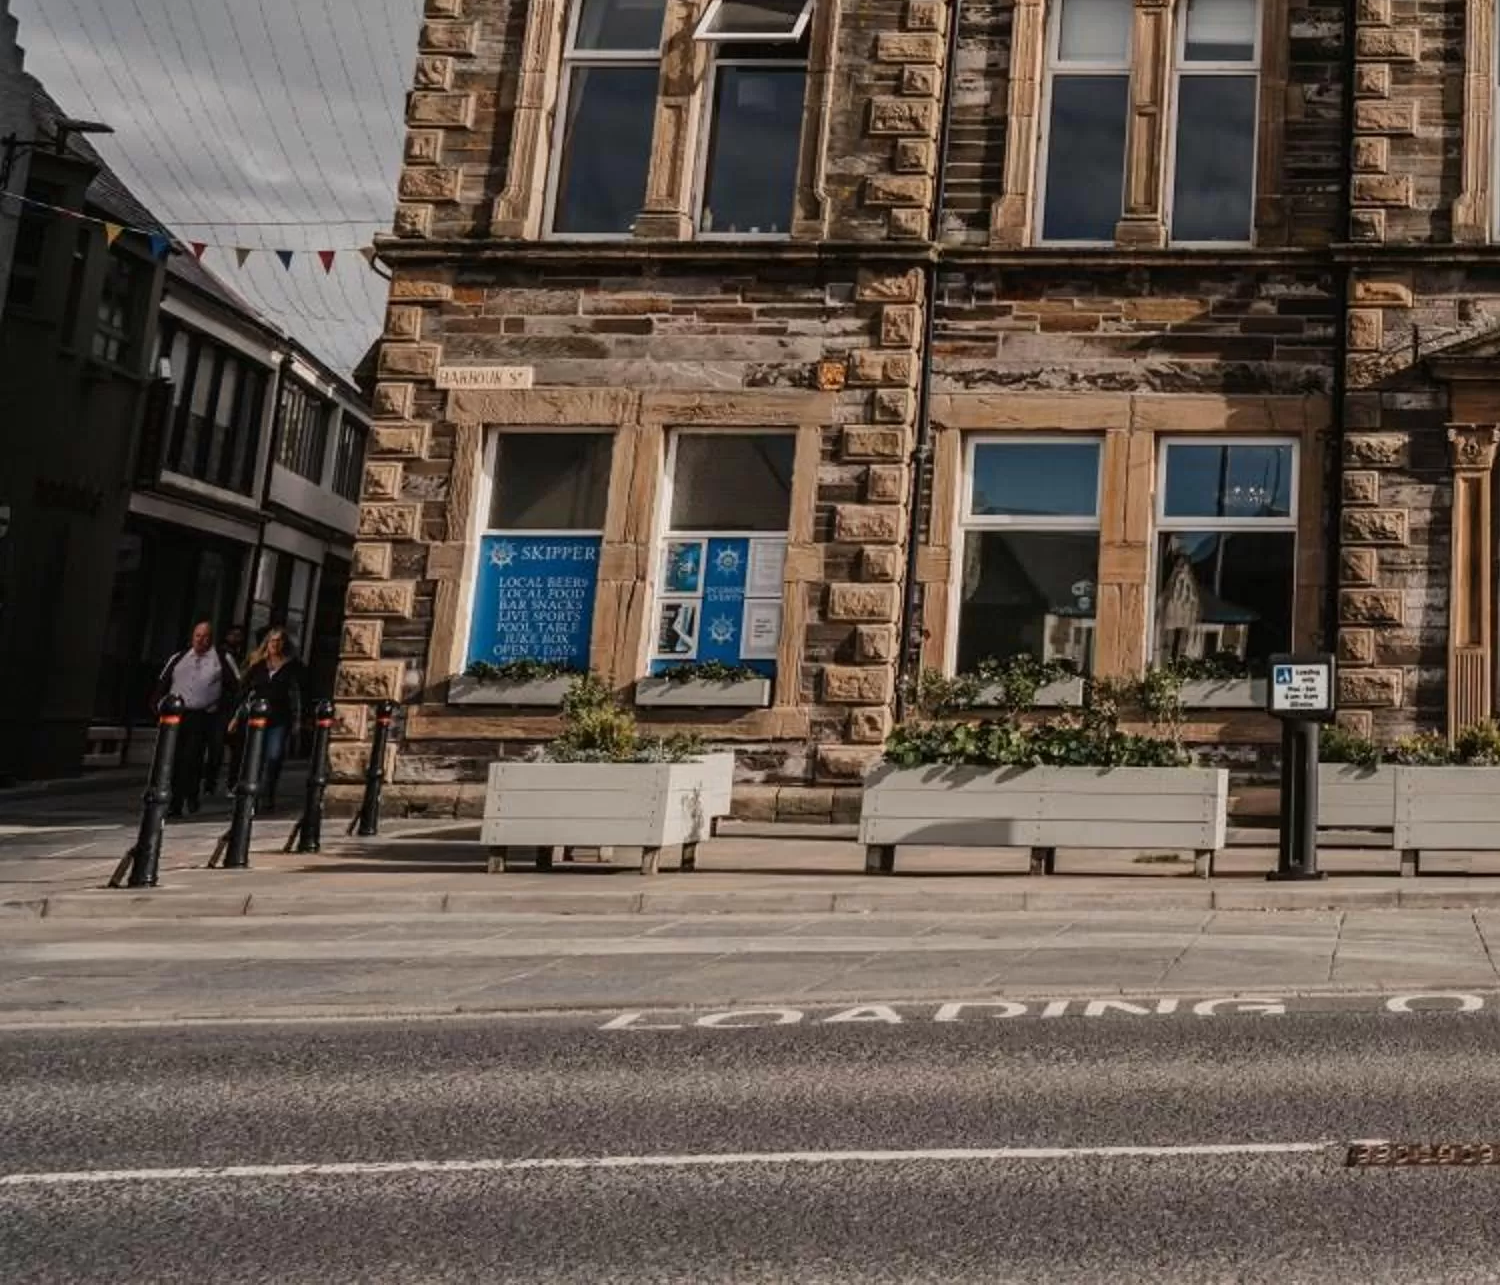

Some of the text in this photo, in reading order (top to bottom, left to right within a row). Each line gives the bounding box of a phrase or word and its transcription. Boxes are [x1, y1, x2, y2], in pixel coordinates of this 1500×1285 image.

[439, 369, 503, 385] HARBOUR
[520, 545, 596, 561] SKIPPER
[498, 577, 589, 588] LOCAL BEERS
[498, 588, 585, 599] LOCAL FOOD
[498, 600, 583, 610] BAR SNACKS
[498, 611, 581, 621] LIVE SPORTS
[496, 622, 579, 633] POOL TABLE
[504, 633, 569, 644] JUKE BOX
[493, 645, 529, 655] OPEN
[543, 645, 577, 656] DAYS
[595, 996, 1287, 1031] LOADING
